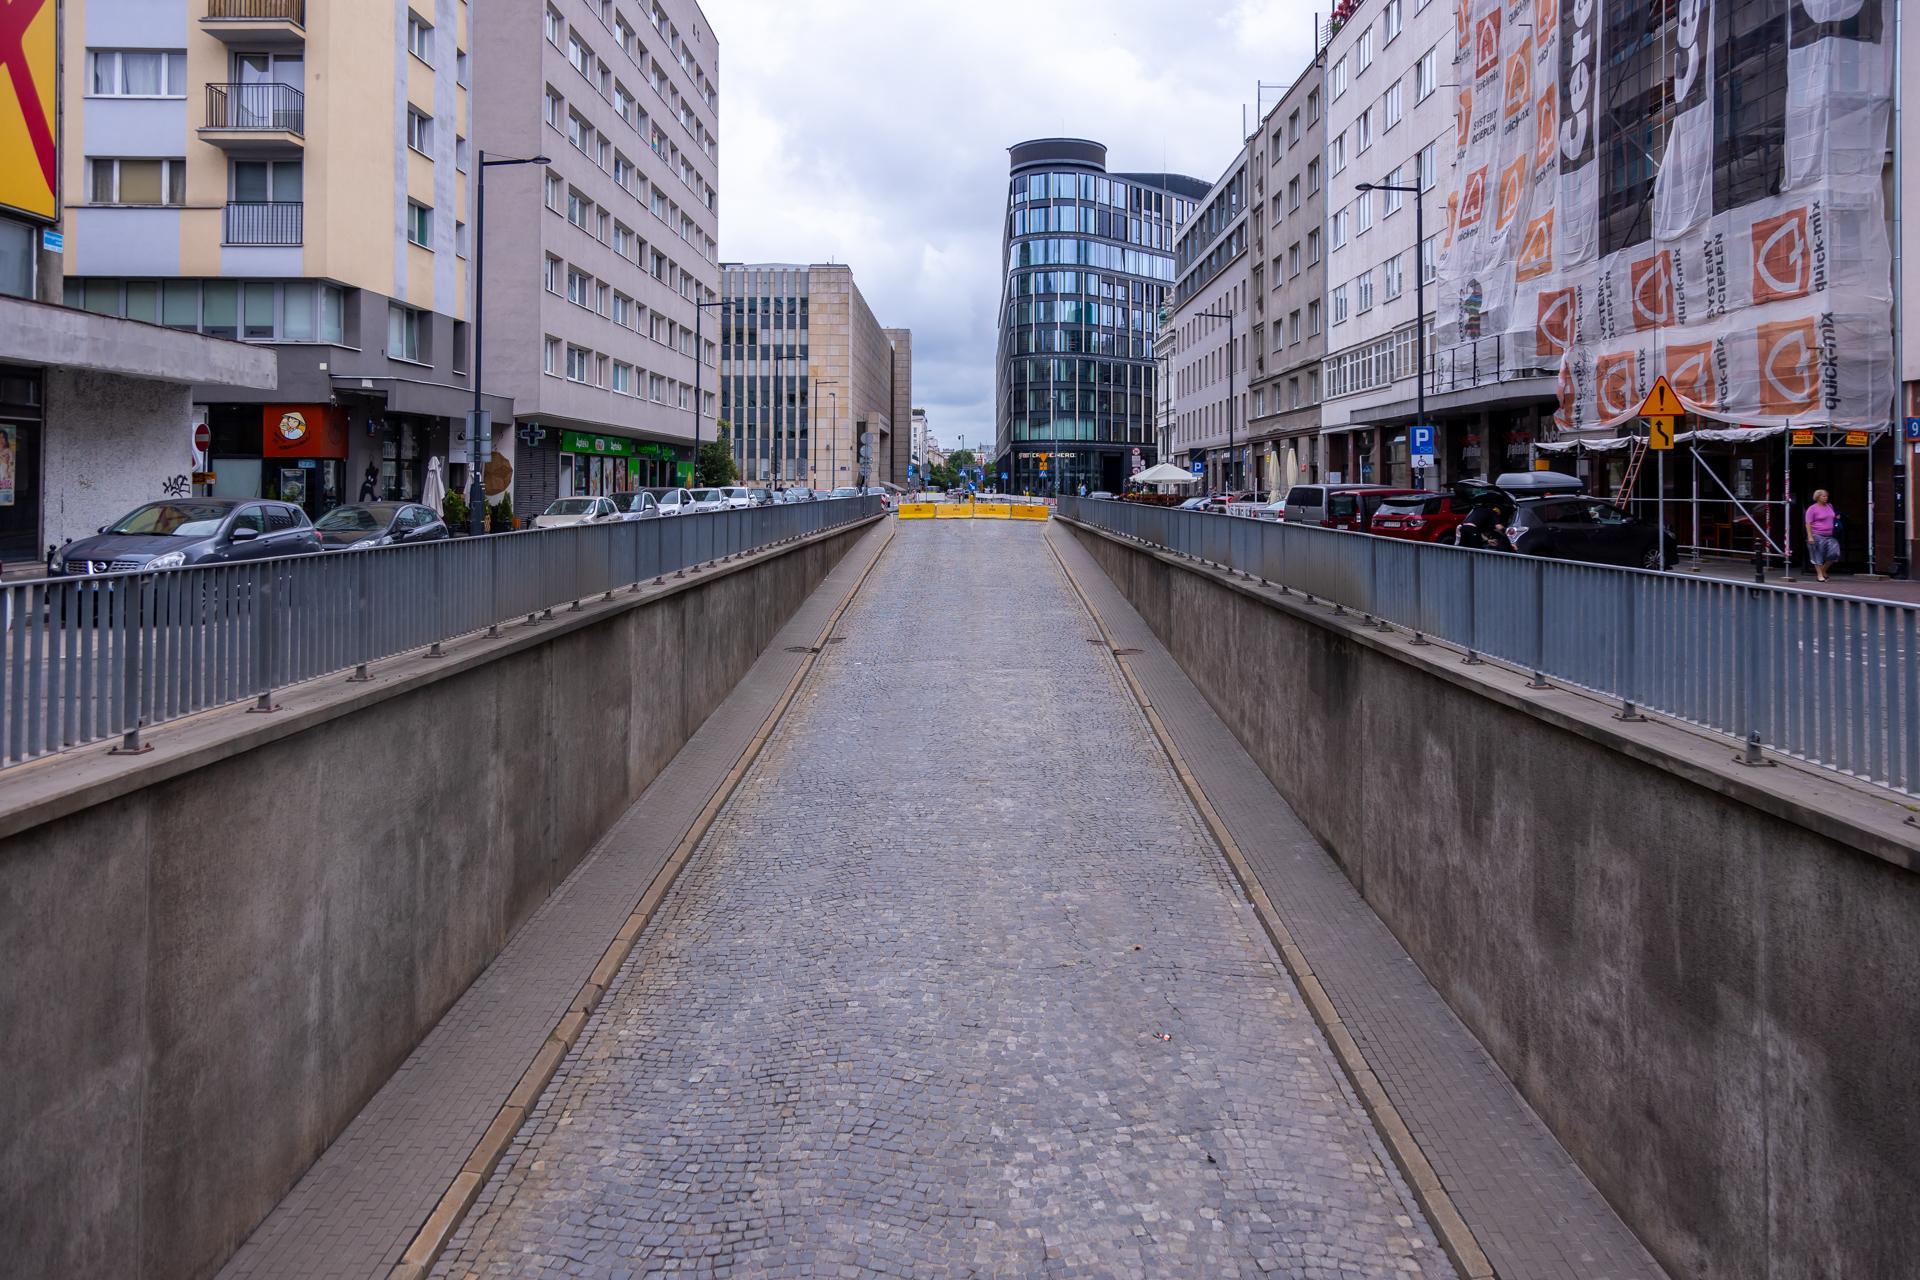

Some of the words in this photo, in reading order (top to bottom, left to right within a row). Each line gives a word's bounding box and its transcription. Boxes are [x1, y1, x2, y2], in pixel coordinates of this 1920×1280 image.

[1704, 240, 1714, 320] SYSTEMY
[1810, 200, 1827, 292] quick-mix
[1672, 248, 1686, 325] quick-mix
[1820, 312, 1839, 410] quick-mix
[1194, 462, 1202, 472] P
[1415, 429, 1429, 447] P
